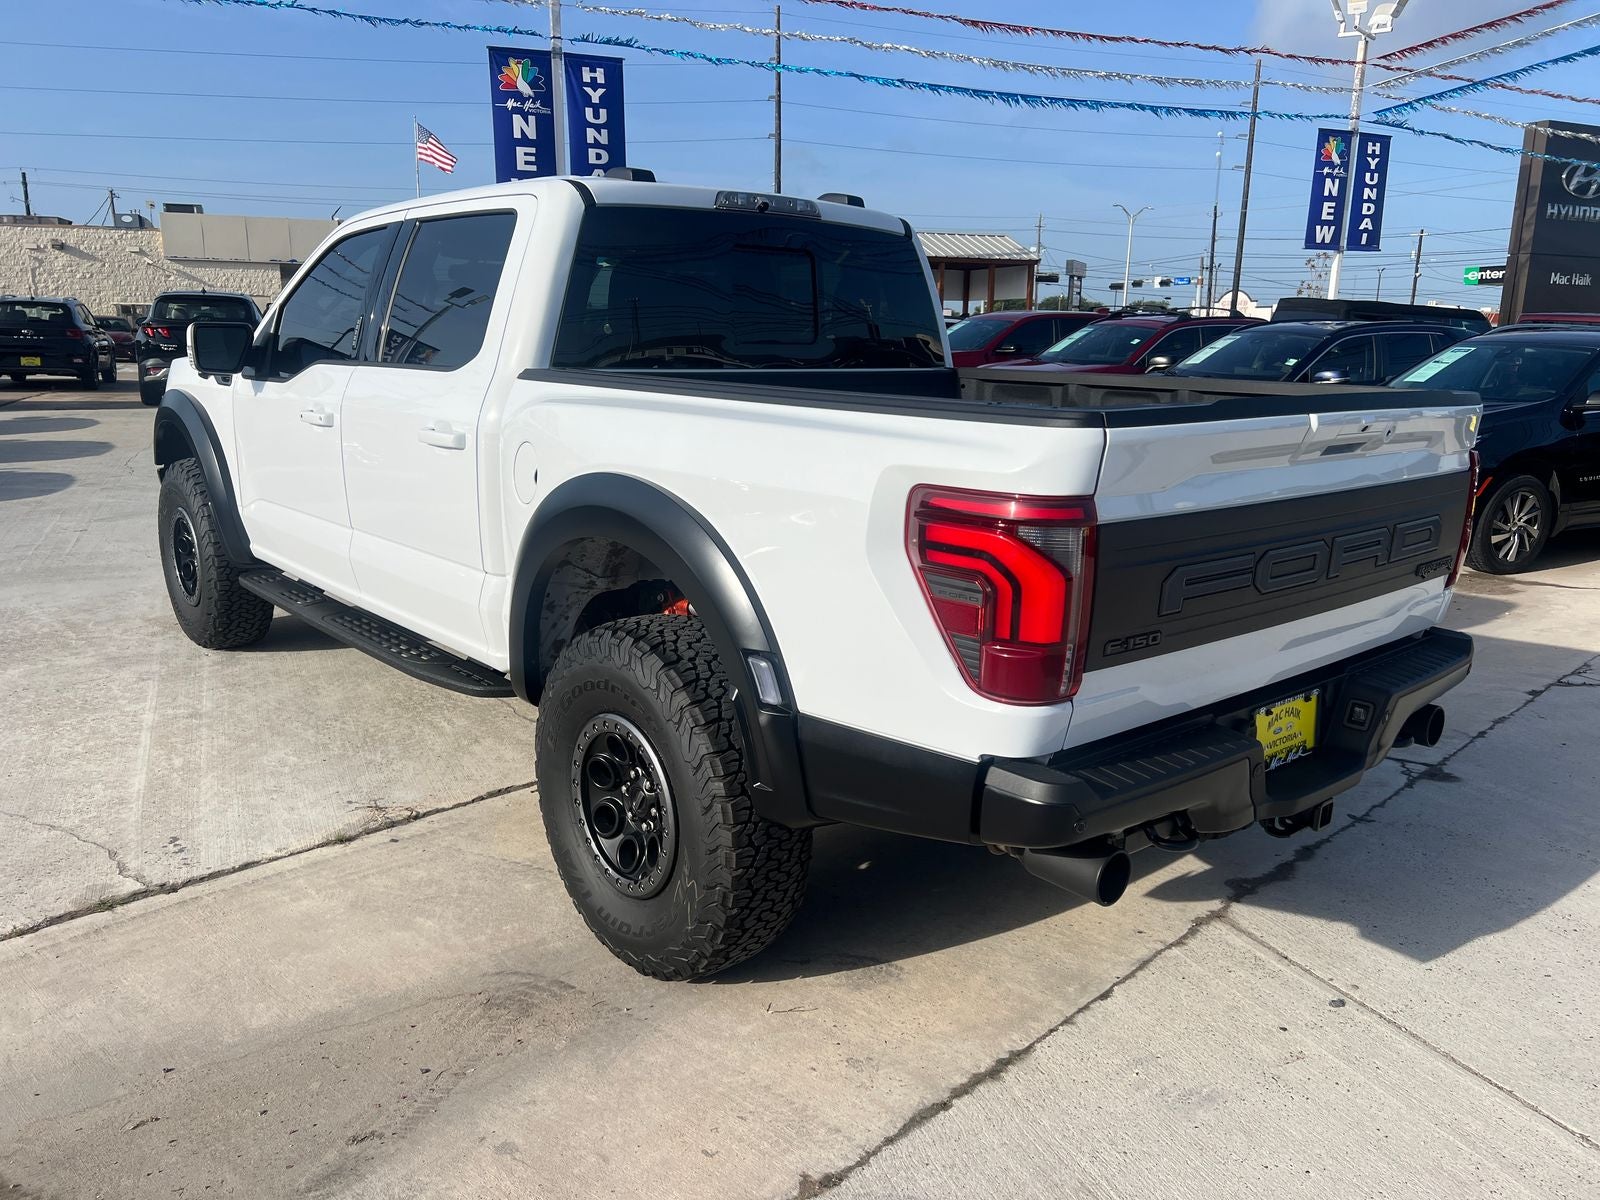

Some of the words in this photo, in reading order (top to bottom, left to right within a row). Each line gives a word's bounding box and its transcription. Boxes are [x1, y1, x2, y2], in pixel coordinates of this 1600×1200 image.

[512, 114, 537, 180] NE
[1315, 178, 1339, 244] NEW
[1358, 142, 1381, 245] HYUNDAI
[1550, 272, 1570, 285] Mac
[1572, 273, 1592, 286] Haik
[938, 590, 979, 603] FORD
[1158, 514, 1443, 618] FORD
[1267, 709, 1284, 732] MAC
[1285, 707, 1301, 720] HAIK
